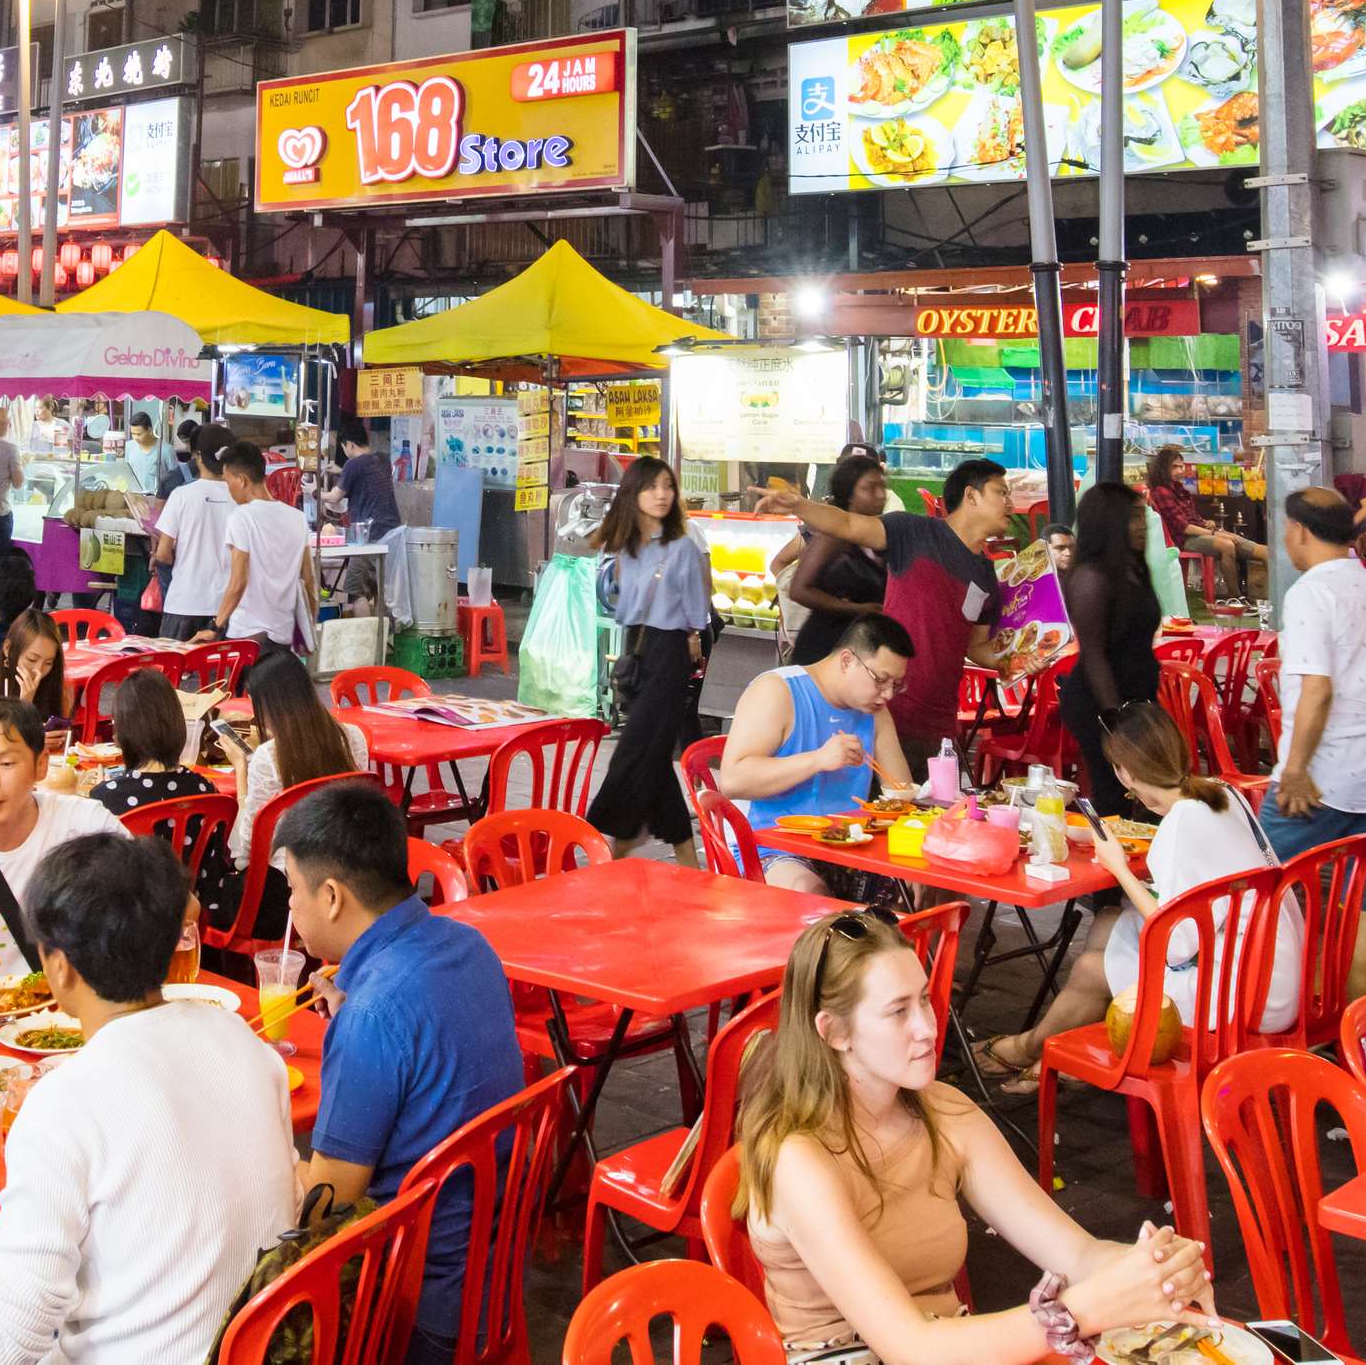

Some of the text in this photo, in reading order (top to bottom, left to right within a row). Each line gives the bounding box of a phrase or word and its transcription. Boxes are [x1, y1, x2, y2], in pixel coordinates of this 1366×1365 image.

[526, 61, 561, 99] 24
[562, 72, 596, 94] HOURS
[269, 88, 321, 108] KEDAI RUNCIT
[345, 74, 463, 184] 168
[794, 120, 842, 146] 支付宝
[459, 132, 572, 177] Store
[795, 142, 841, 156] ALIPAY
[609, 390, 658, 405] ASAM LAKSA
